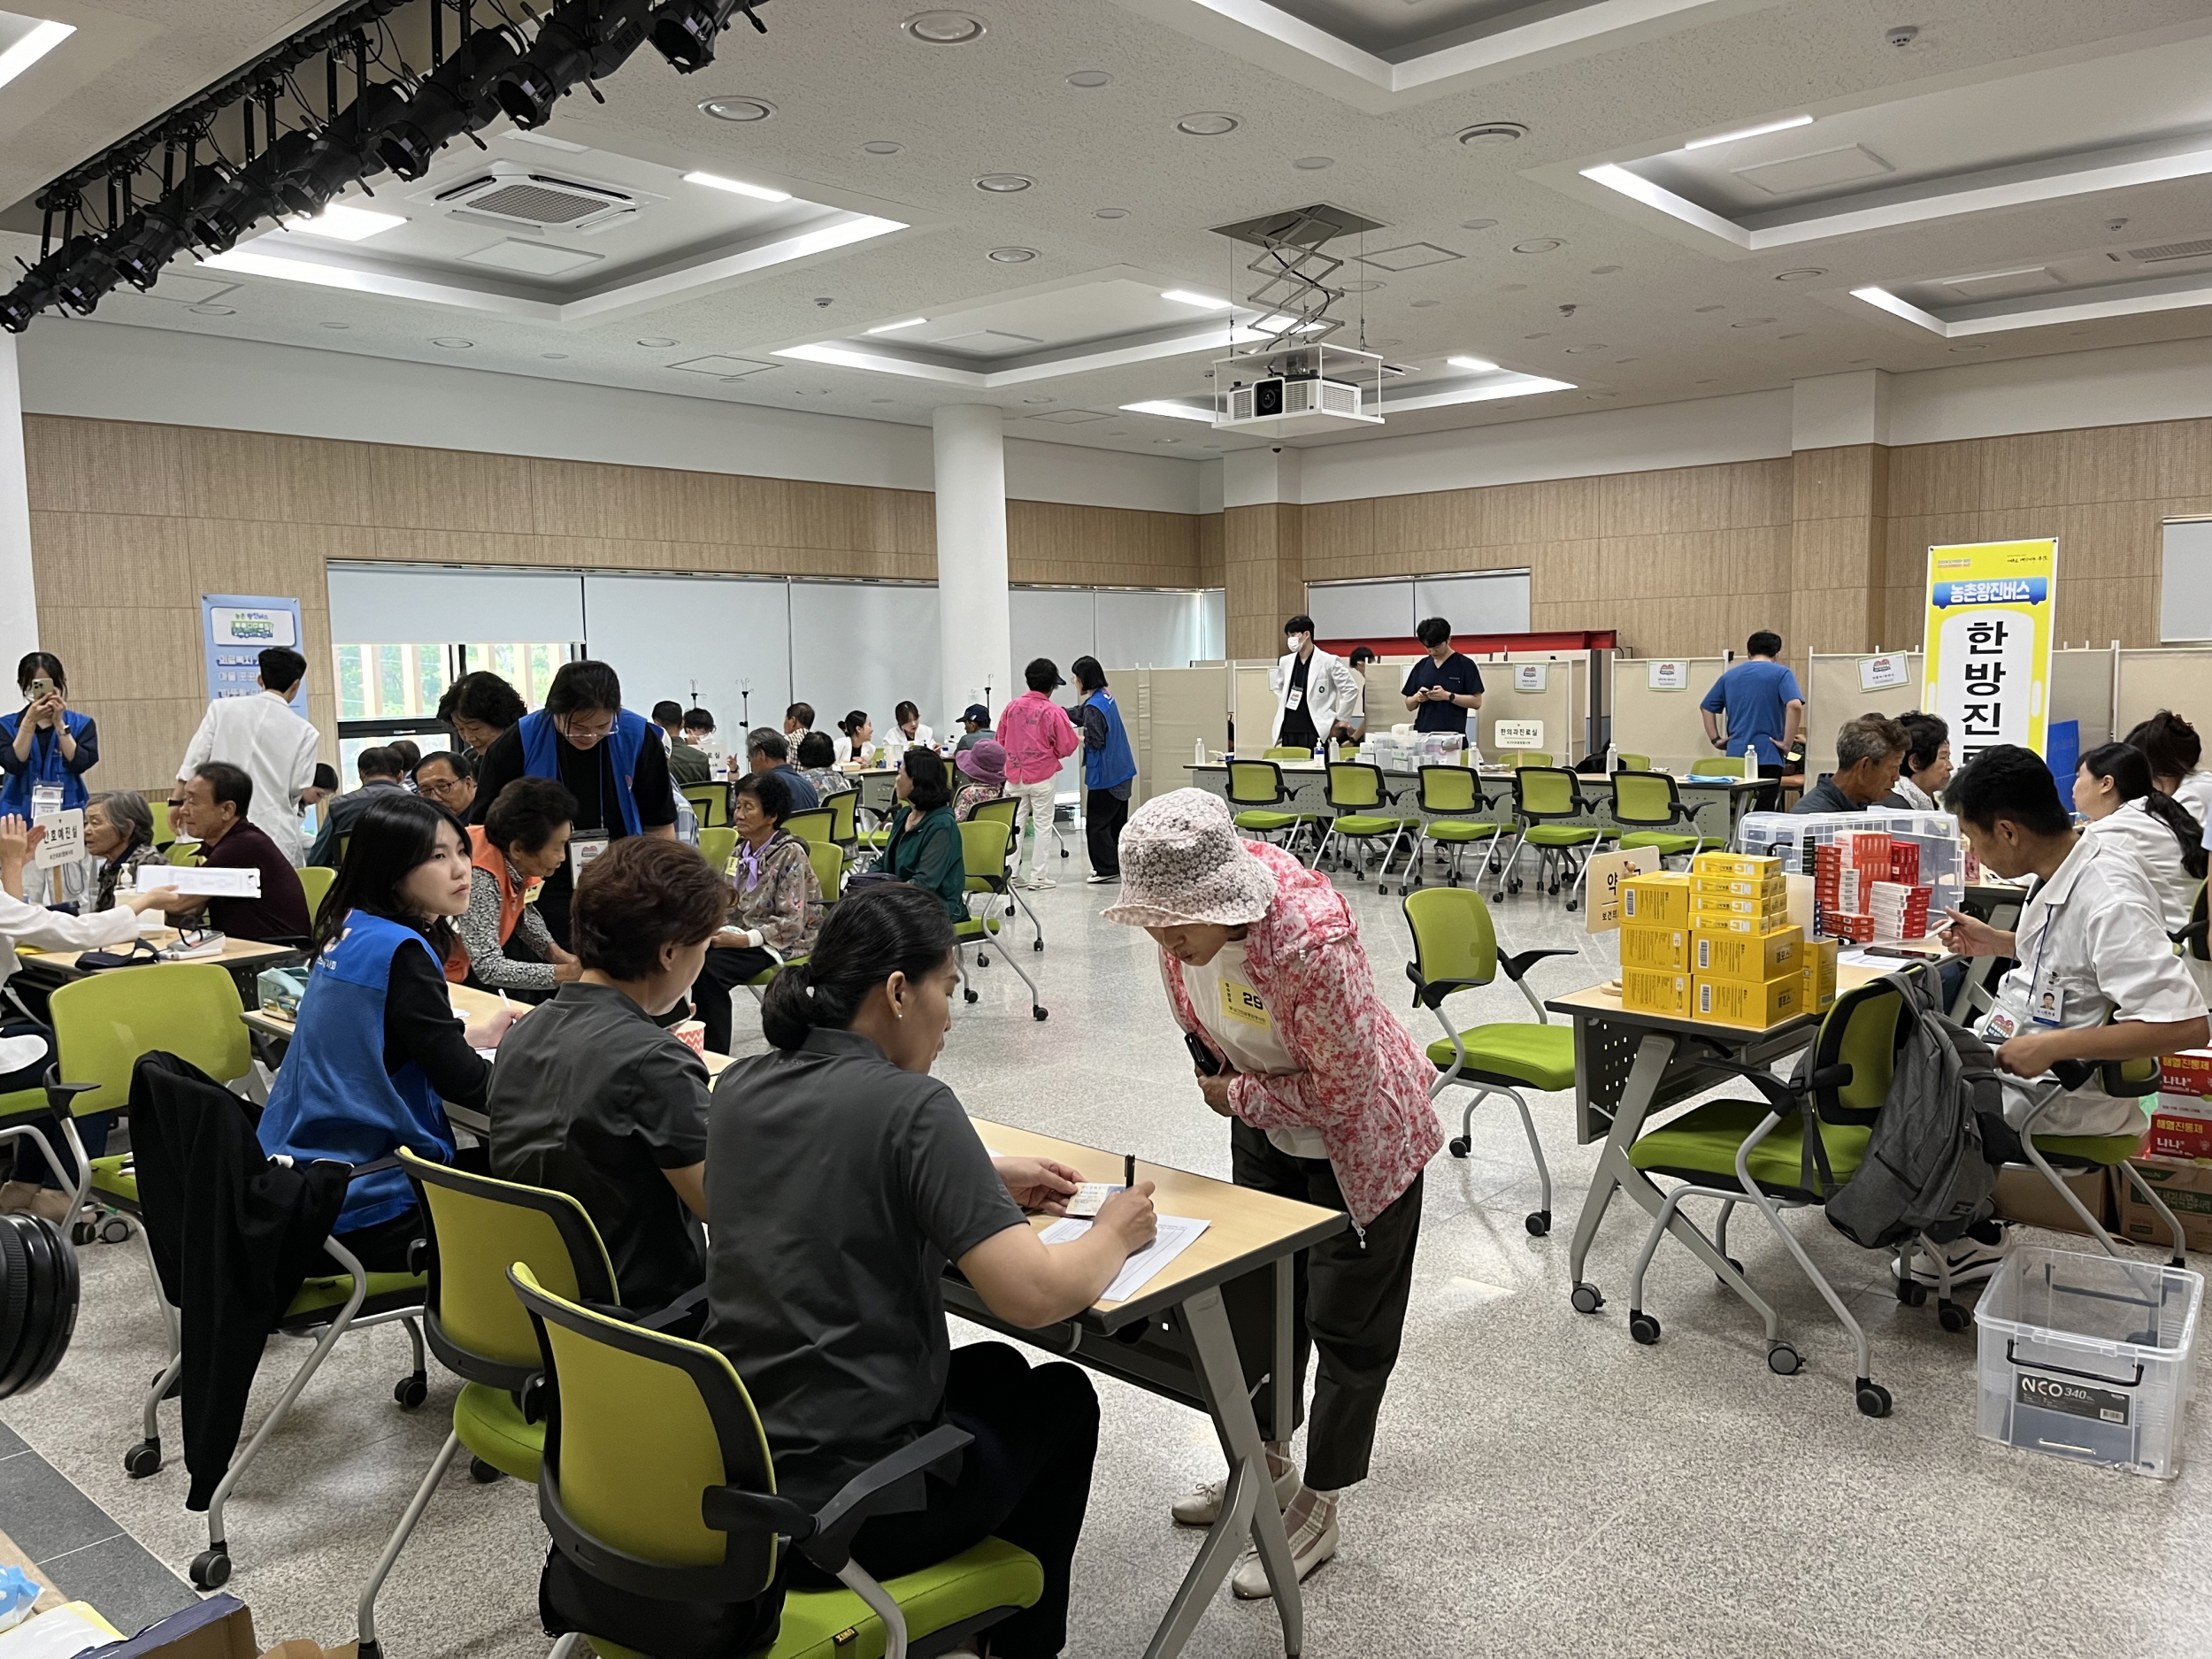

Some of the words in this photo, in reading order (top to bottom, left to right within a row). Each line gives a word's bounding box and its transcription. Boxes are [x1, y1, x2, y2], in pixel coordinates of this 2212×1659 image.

[1950, 580, 2030, 603] 농촌왕진버스
[1961, 621, 2008, 766] 한방진
[1500, 728, 1538, 737] 한의과진료실
[1601, 909, 1619, 921] 보건의
[1242, 991, 1263, 1010] 29
[2162, 1056, 2210, 1071] 해열진통제
[2156, 1119, 2203, 1133] 해열진통제
[2022, 1377, 2063, 1398] NEO
[2063, 1387, 2087, 1400] 340
